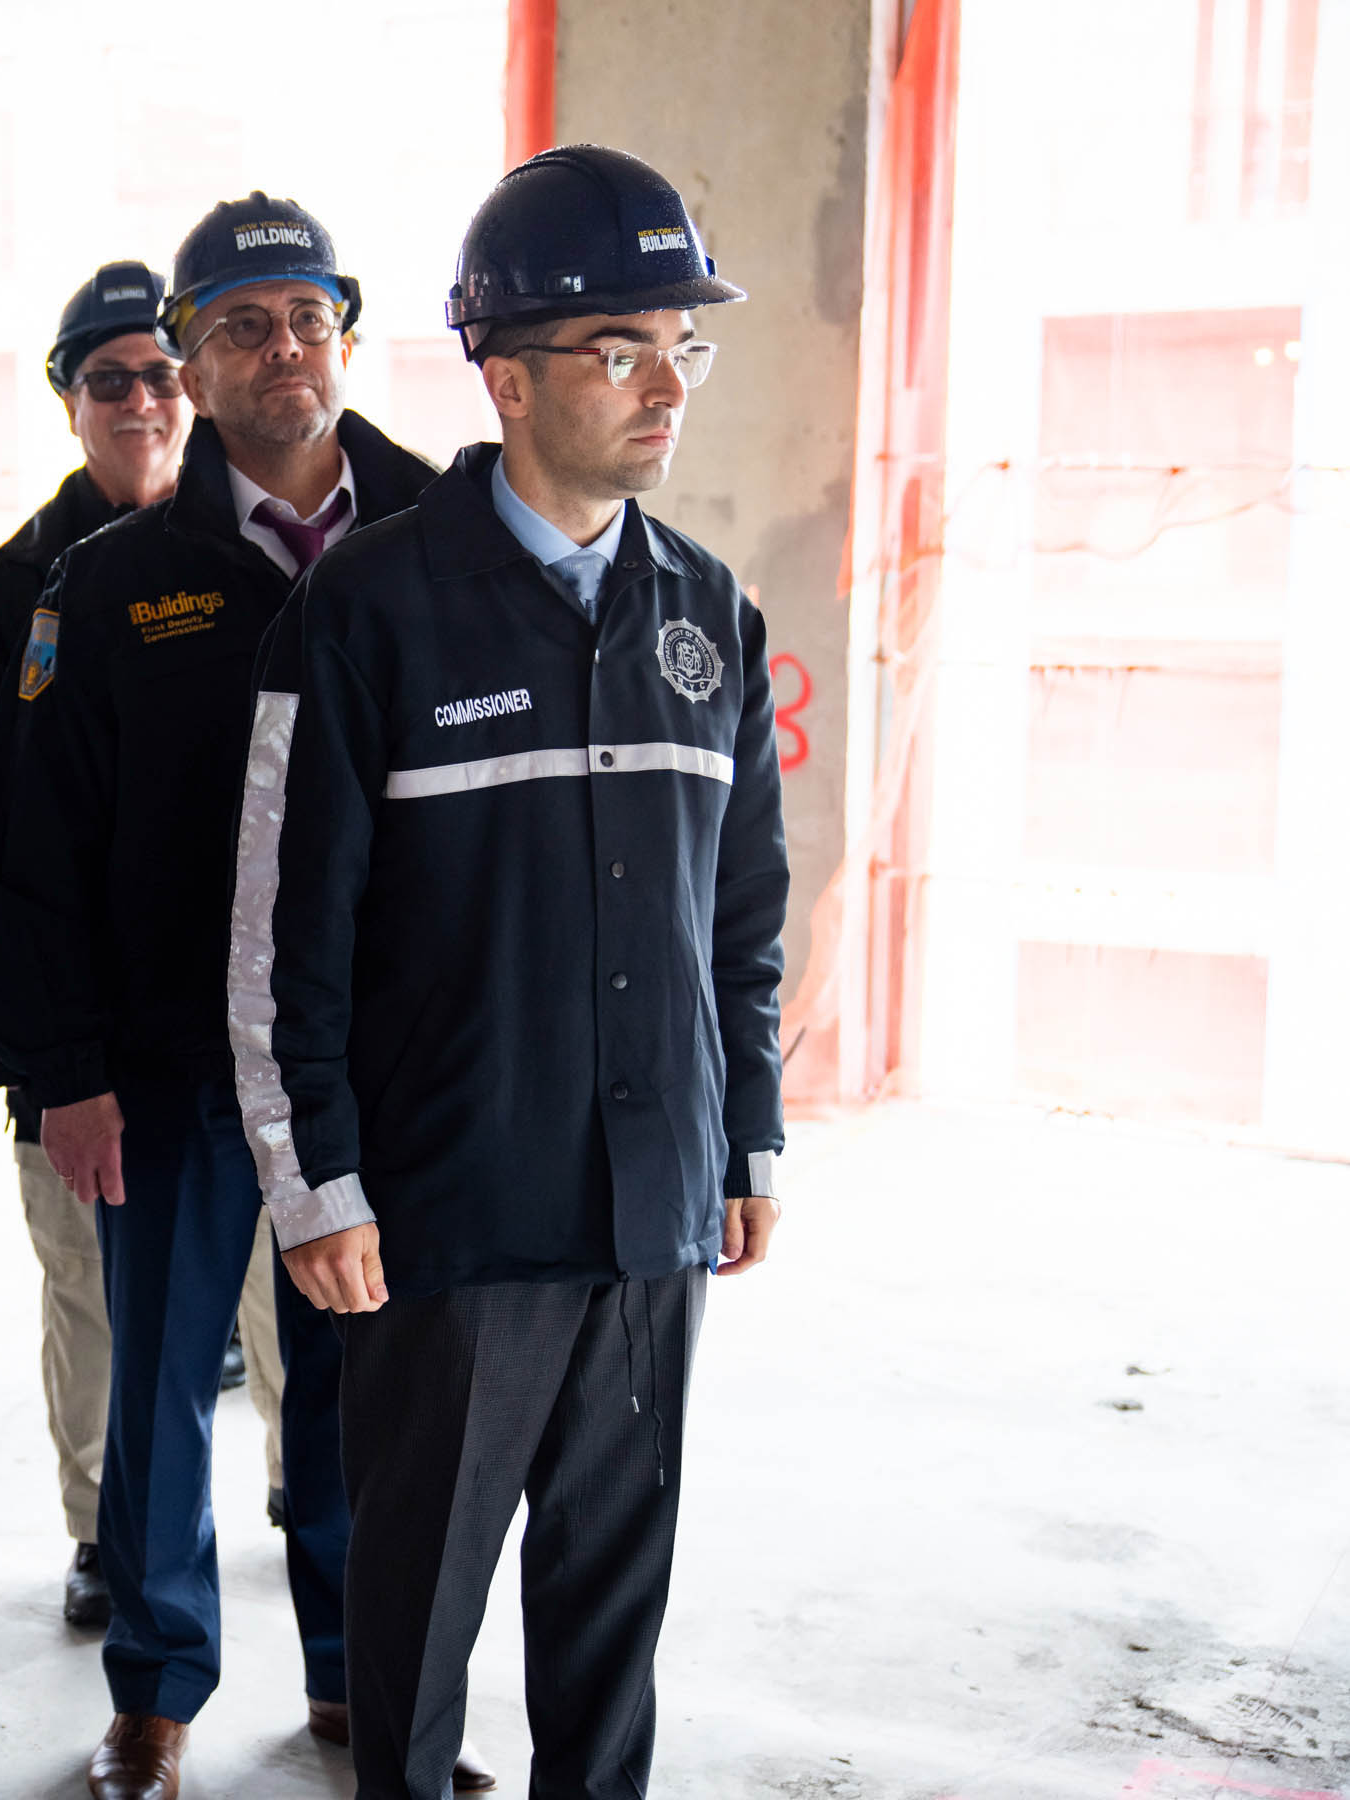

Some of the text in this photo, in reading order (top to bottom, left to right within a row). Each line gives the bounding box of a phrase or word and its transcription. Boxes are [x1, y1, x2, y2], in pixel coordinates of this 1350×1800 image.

[234, 223, 258, 234] NEW
[259, 221, 286, 229] YORK
[638, 229, 654, 237] NEW
[656, 227, 672, 235] YORK
[235, 228, 312, 251] BUILDINGS
[639, 233, 688, 253] BUILDINGS
[135, 591, 225, 624] Buildings
[144, 621, 216, 643] Commissioner
[167, 615, 203, 629] Deputy
[665, 629, 684, 671] DEPARTMENT
[694, 636, 713, 678] BUILDINGS
[434, 688, 532, 727] COMMISSIONER
